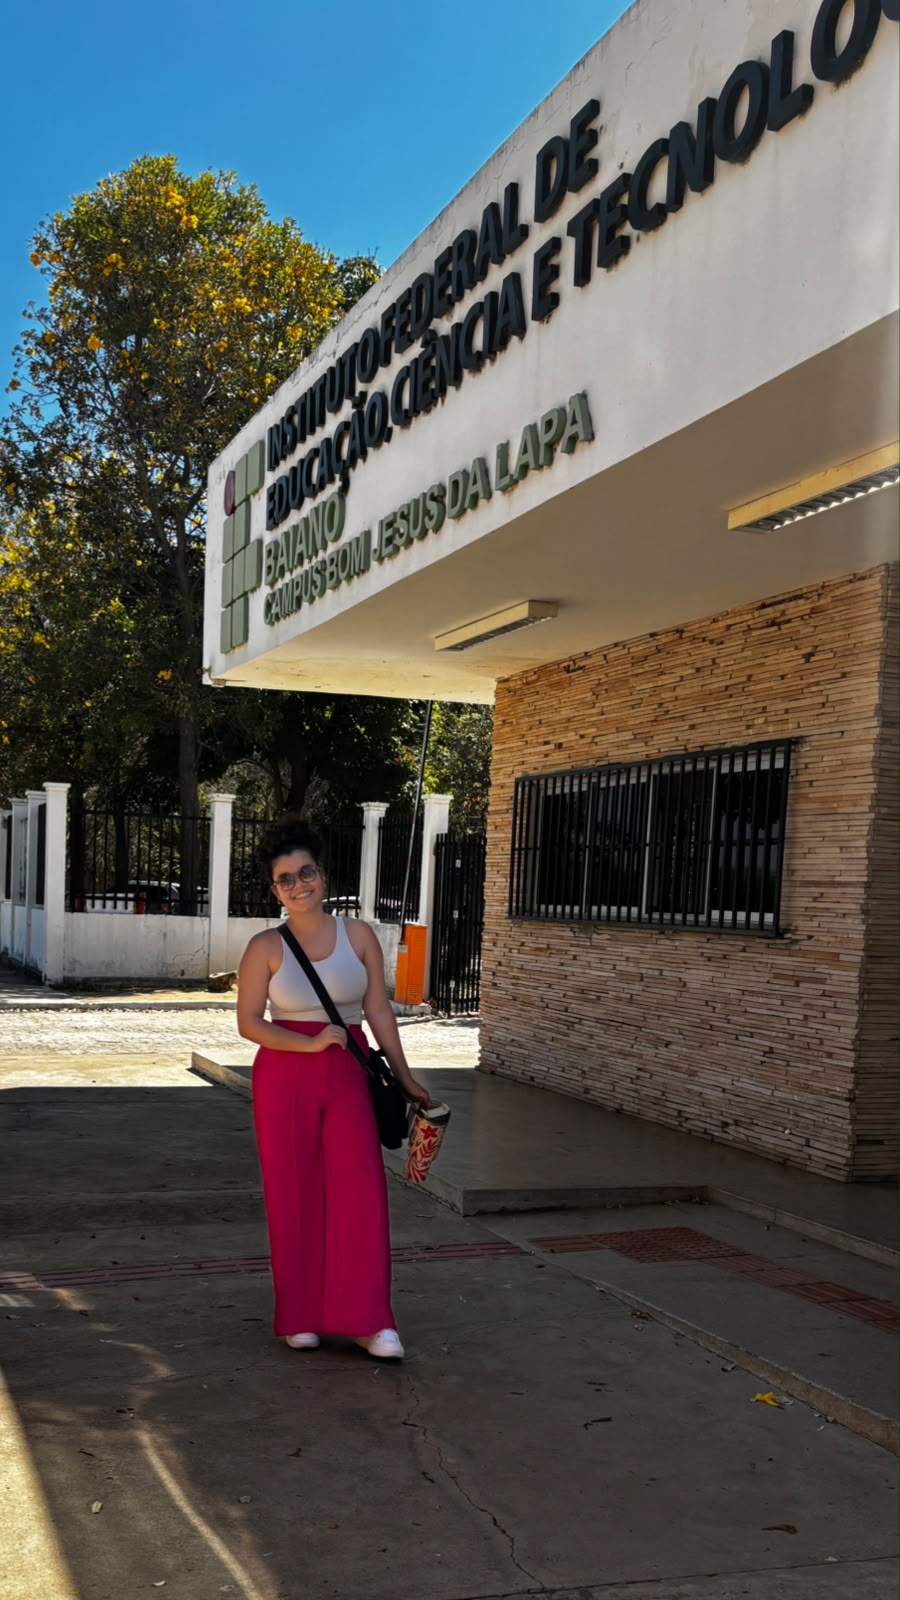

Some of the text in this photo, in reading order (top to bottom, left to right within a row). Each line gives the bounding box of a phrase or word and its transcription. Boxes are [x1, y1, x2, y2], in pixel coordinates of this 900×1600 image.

[266, 0, 899, 531] EDUCAÇÃO, CIÊNCIA E TECNOLO
[267, 99, 600, 472] INSTITUTO FEDERAL DE
[264, 391, 595, 626] CAMPUS BOM JESUS DA LAPA
[264, 491, 346, 586] BAIANO
